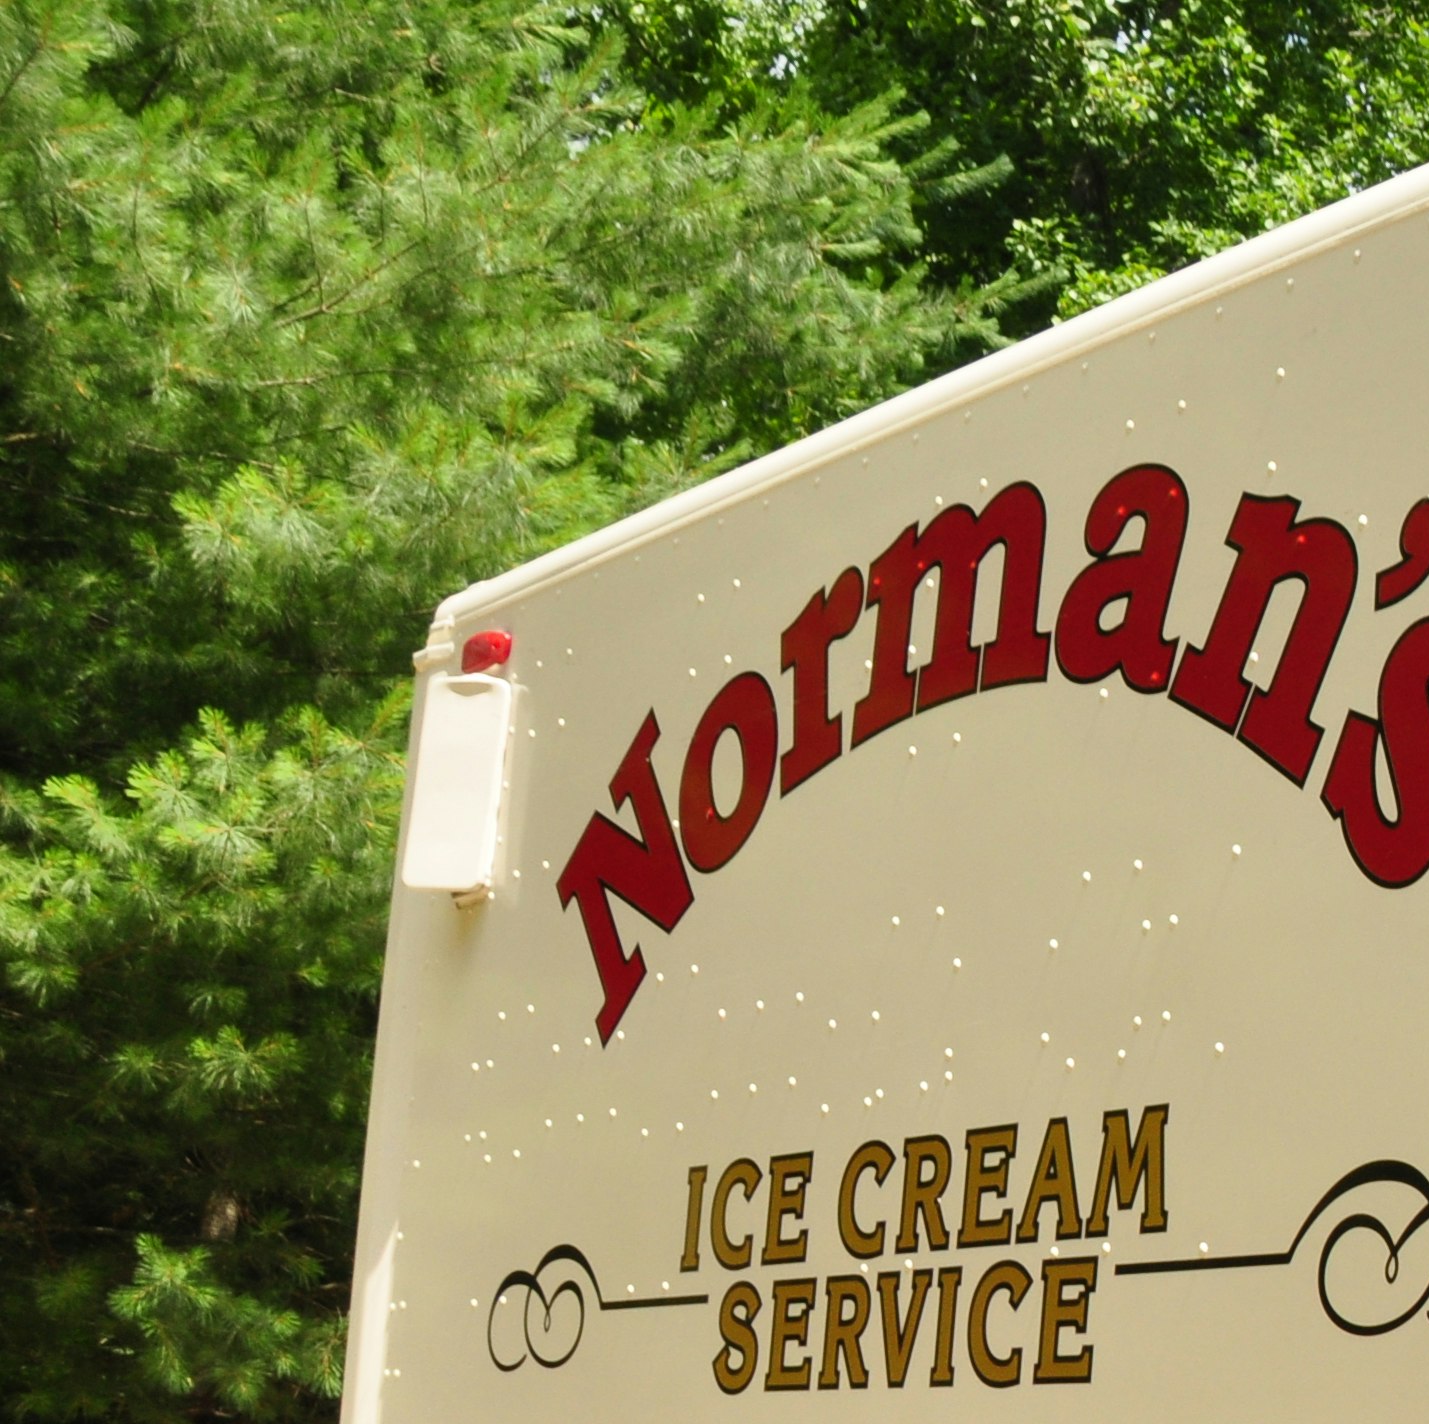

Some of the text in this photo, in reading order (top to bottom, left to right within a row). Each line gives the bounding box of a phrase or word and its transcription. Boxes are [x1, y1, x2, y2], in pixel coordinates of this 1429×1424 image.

[680, 1103, 1170, 1272] ICE CREAM
[712, 1255, 1099, 1394] SERVICE
